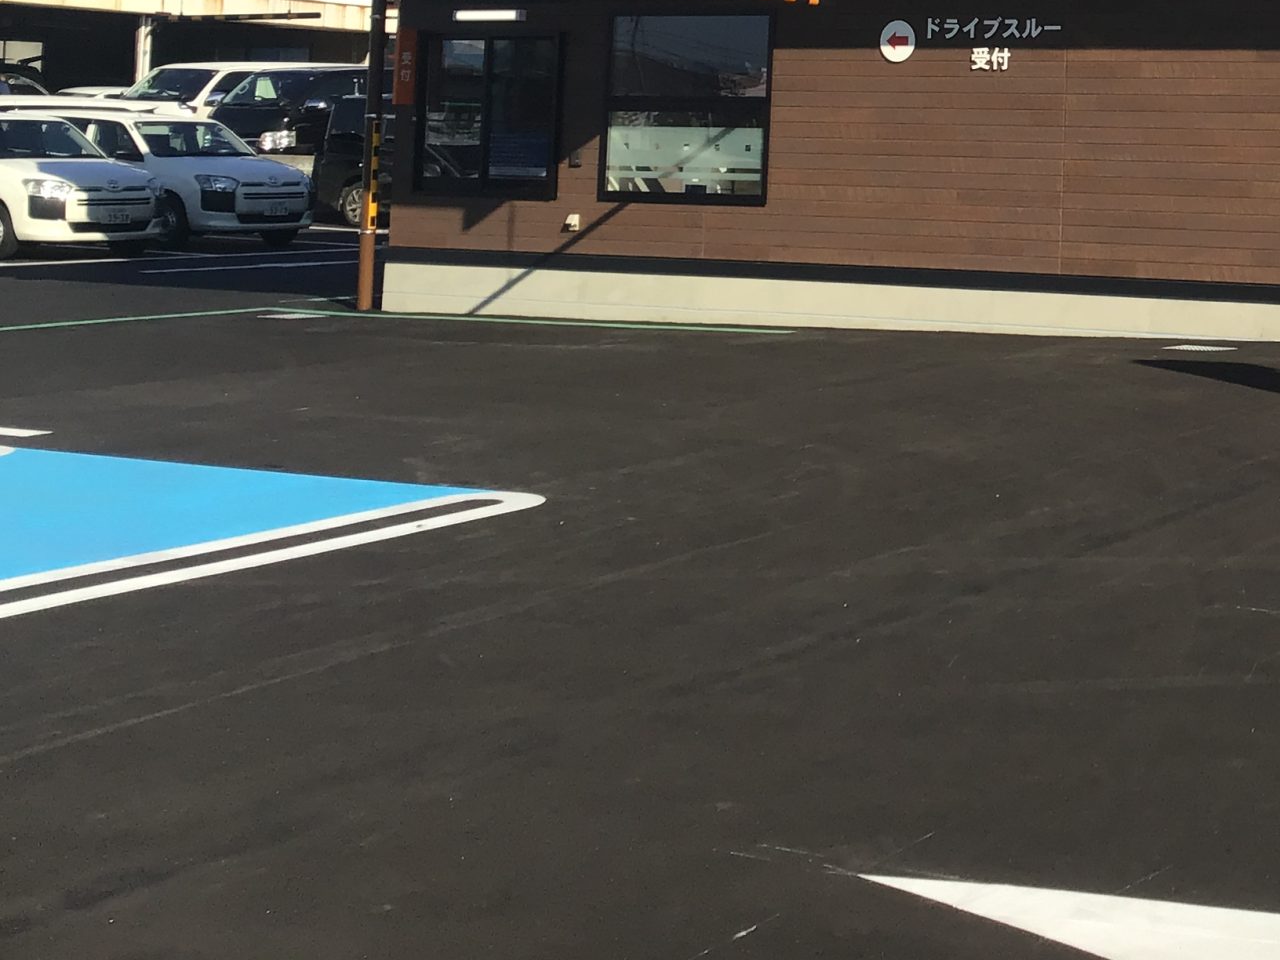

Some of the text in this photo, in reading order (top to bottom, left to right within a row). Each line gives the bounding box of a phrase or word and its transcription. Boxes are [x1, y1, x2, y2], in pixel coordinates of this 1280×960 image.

[925, 16, 1062, 39] ドライブスルー
[970, 46, 1012, 71] 受付
